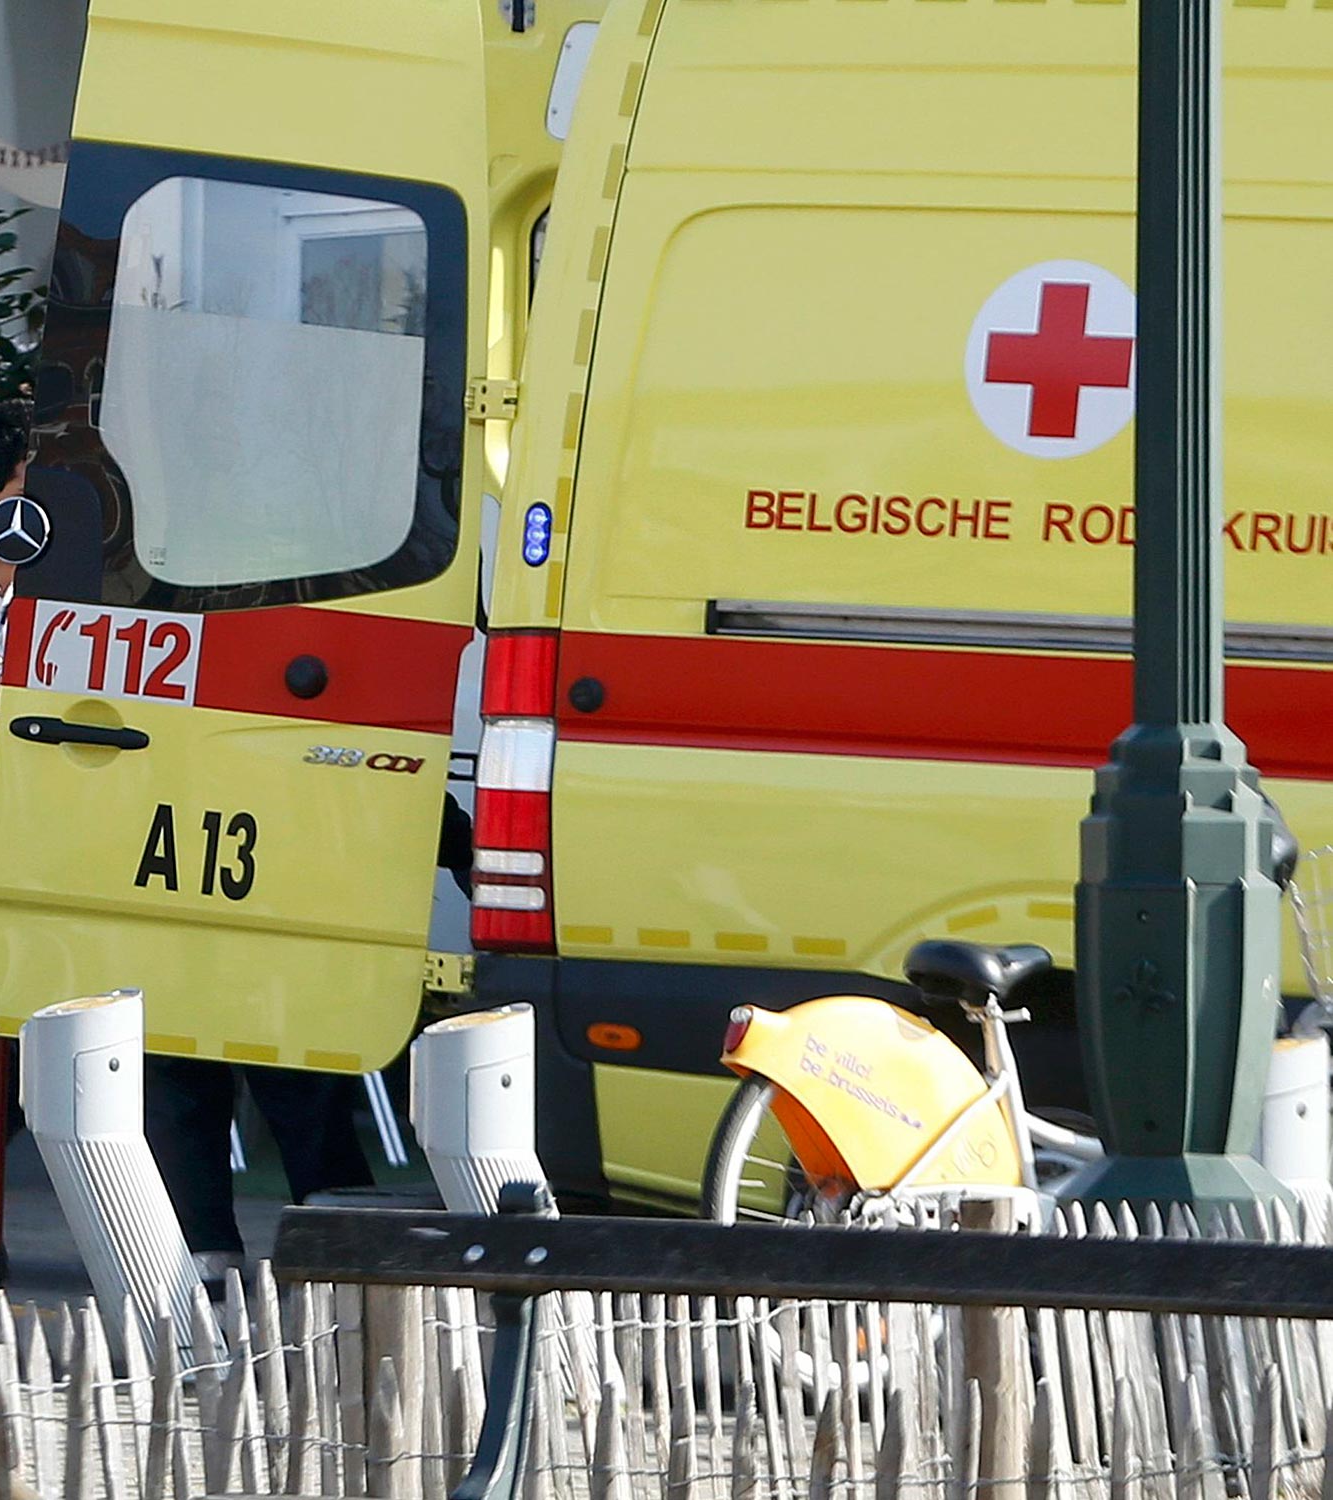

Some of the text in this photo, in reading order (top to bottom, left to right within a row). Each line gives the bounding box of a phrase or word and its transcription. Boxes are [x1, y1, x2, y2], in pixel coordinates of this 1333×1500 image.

[745, 490, 1333, 555] BELGISCHE ROD KRUI
[80, 614, 192, 700] 112
[303, 745, 425, 774] 313 CDI
[134, 804, 257, 900] A 13
[800, 1053, 822, 1078] be
[805, 1032, 827, 1057] be
